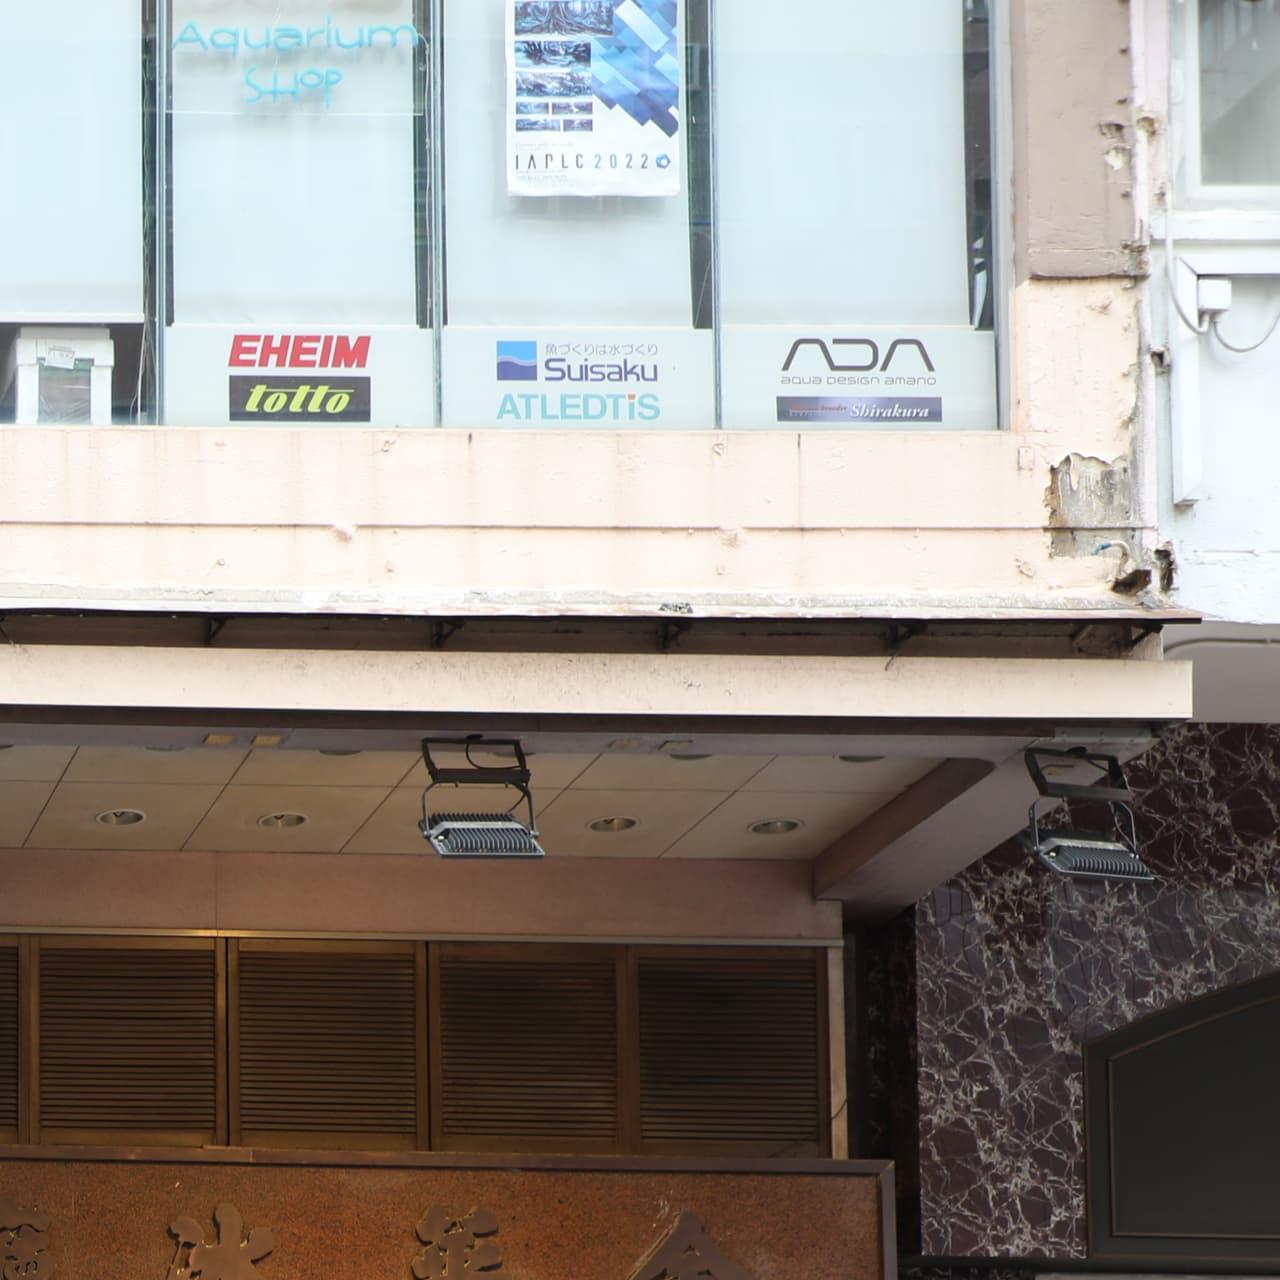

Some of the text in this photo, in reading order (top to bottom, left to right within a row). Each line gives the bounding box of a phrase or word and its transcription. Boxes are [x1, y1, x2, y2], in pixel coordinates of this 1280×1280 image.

[172, 12, 420, 58] Aquarium
[593, 153, 649, 169] 2022
[228, 334, 371, 368] EHEIM
[781, 338, 936, 372] ADA
[544, 357, 659, 382] Suisaku
[849, 403, 930, 417] Shirakura
